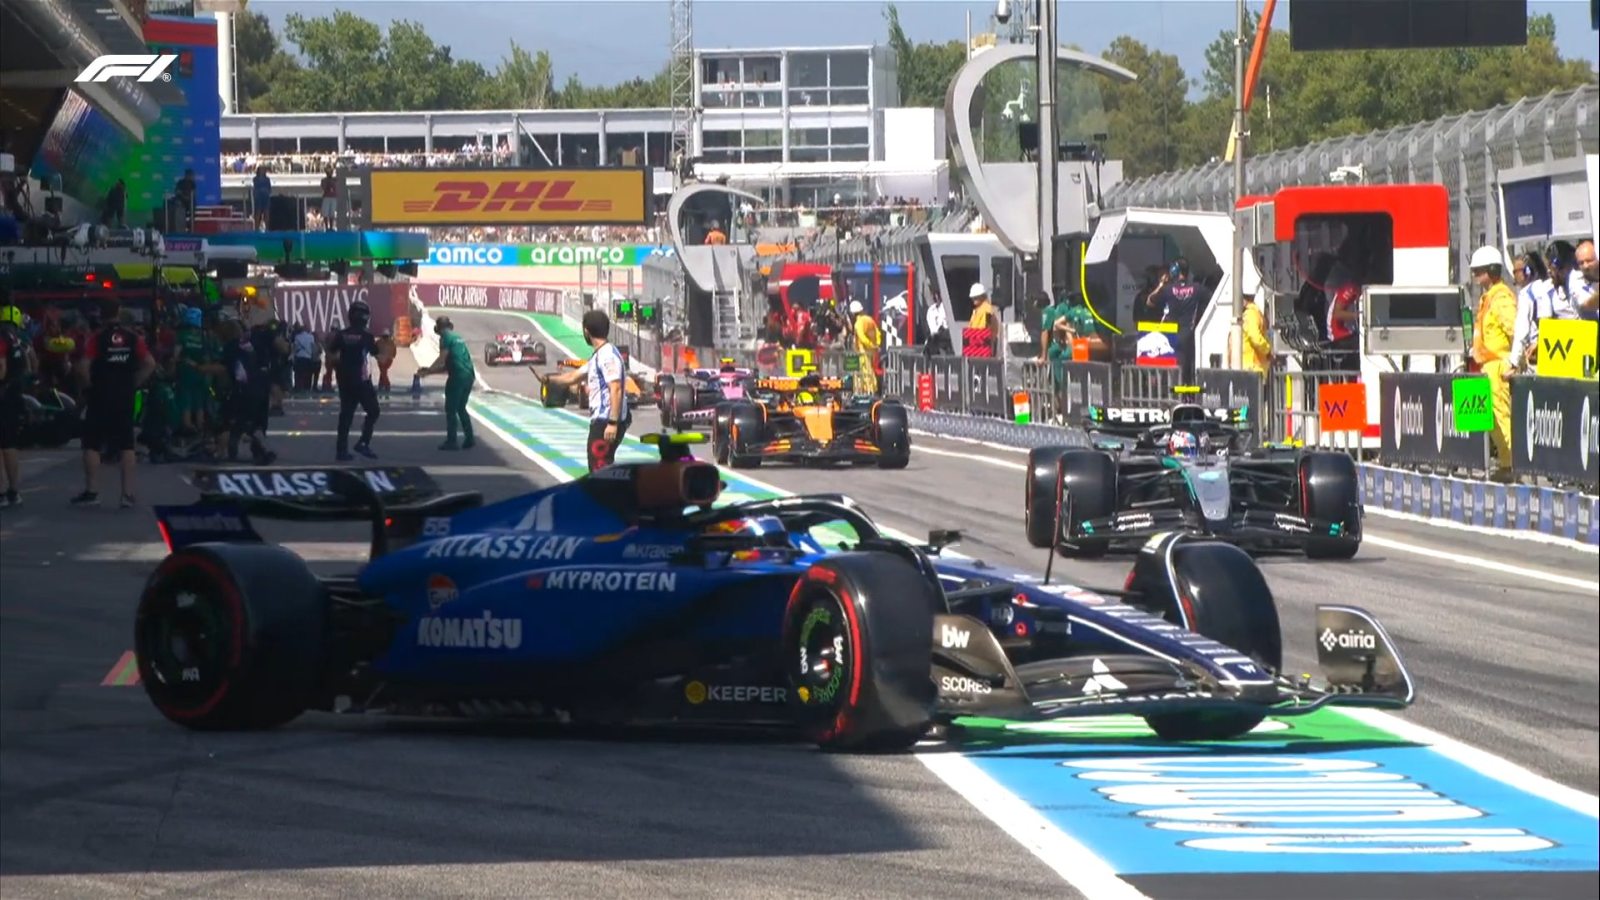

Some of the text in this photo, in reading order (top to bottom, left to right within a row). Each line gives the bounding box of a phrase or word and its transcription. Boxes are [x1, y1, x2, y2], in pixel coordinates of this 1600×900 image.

[431, 181, 584, 211] DHL
[429, 246, 503, 265] ramco
[531, 246, 625, 264] aramco
[438, 285, 488, 308] QATAR AIRWAYS
[1534, 400, 1563, 449] motorola
[217, 470, 396, 496] ATLASSN
[422, 518, 451, 537] 55
[425, 534, 585, 560] ATLASSIAN
[546, 571, 677, 592] MYPROTEIN
[417, 610, 522, 649] KOMATSU
[942, 624, 971, 648] bw
[1338, 630, 1375, 649] airia
[708, 685, 787, 702] KEEPER
[942, 676, 992, 694] SCORES
